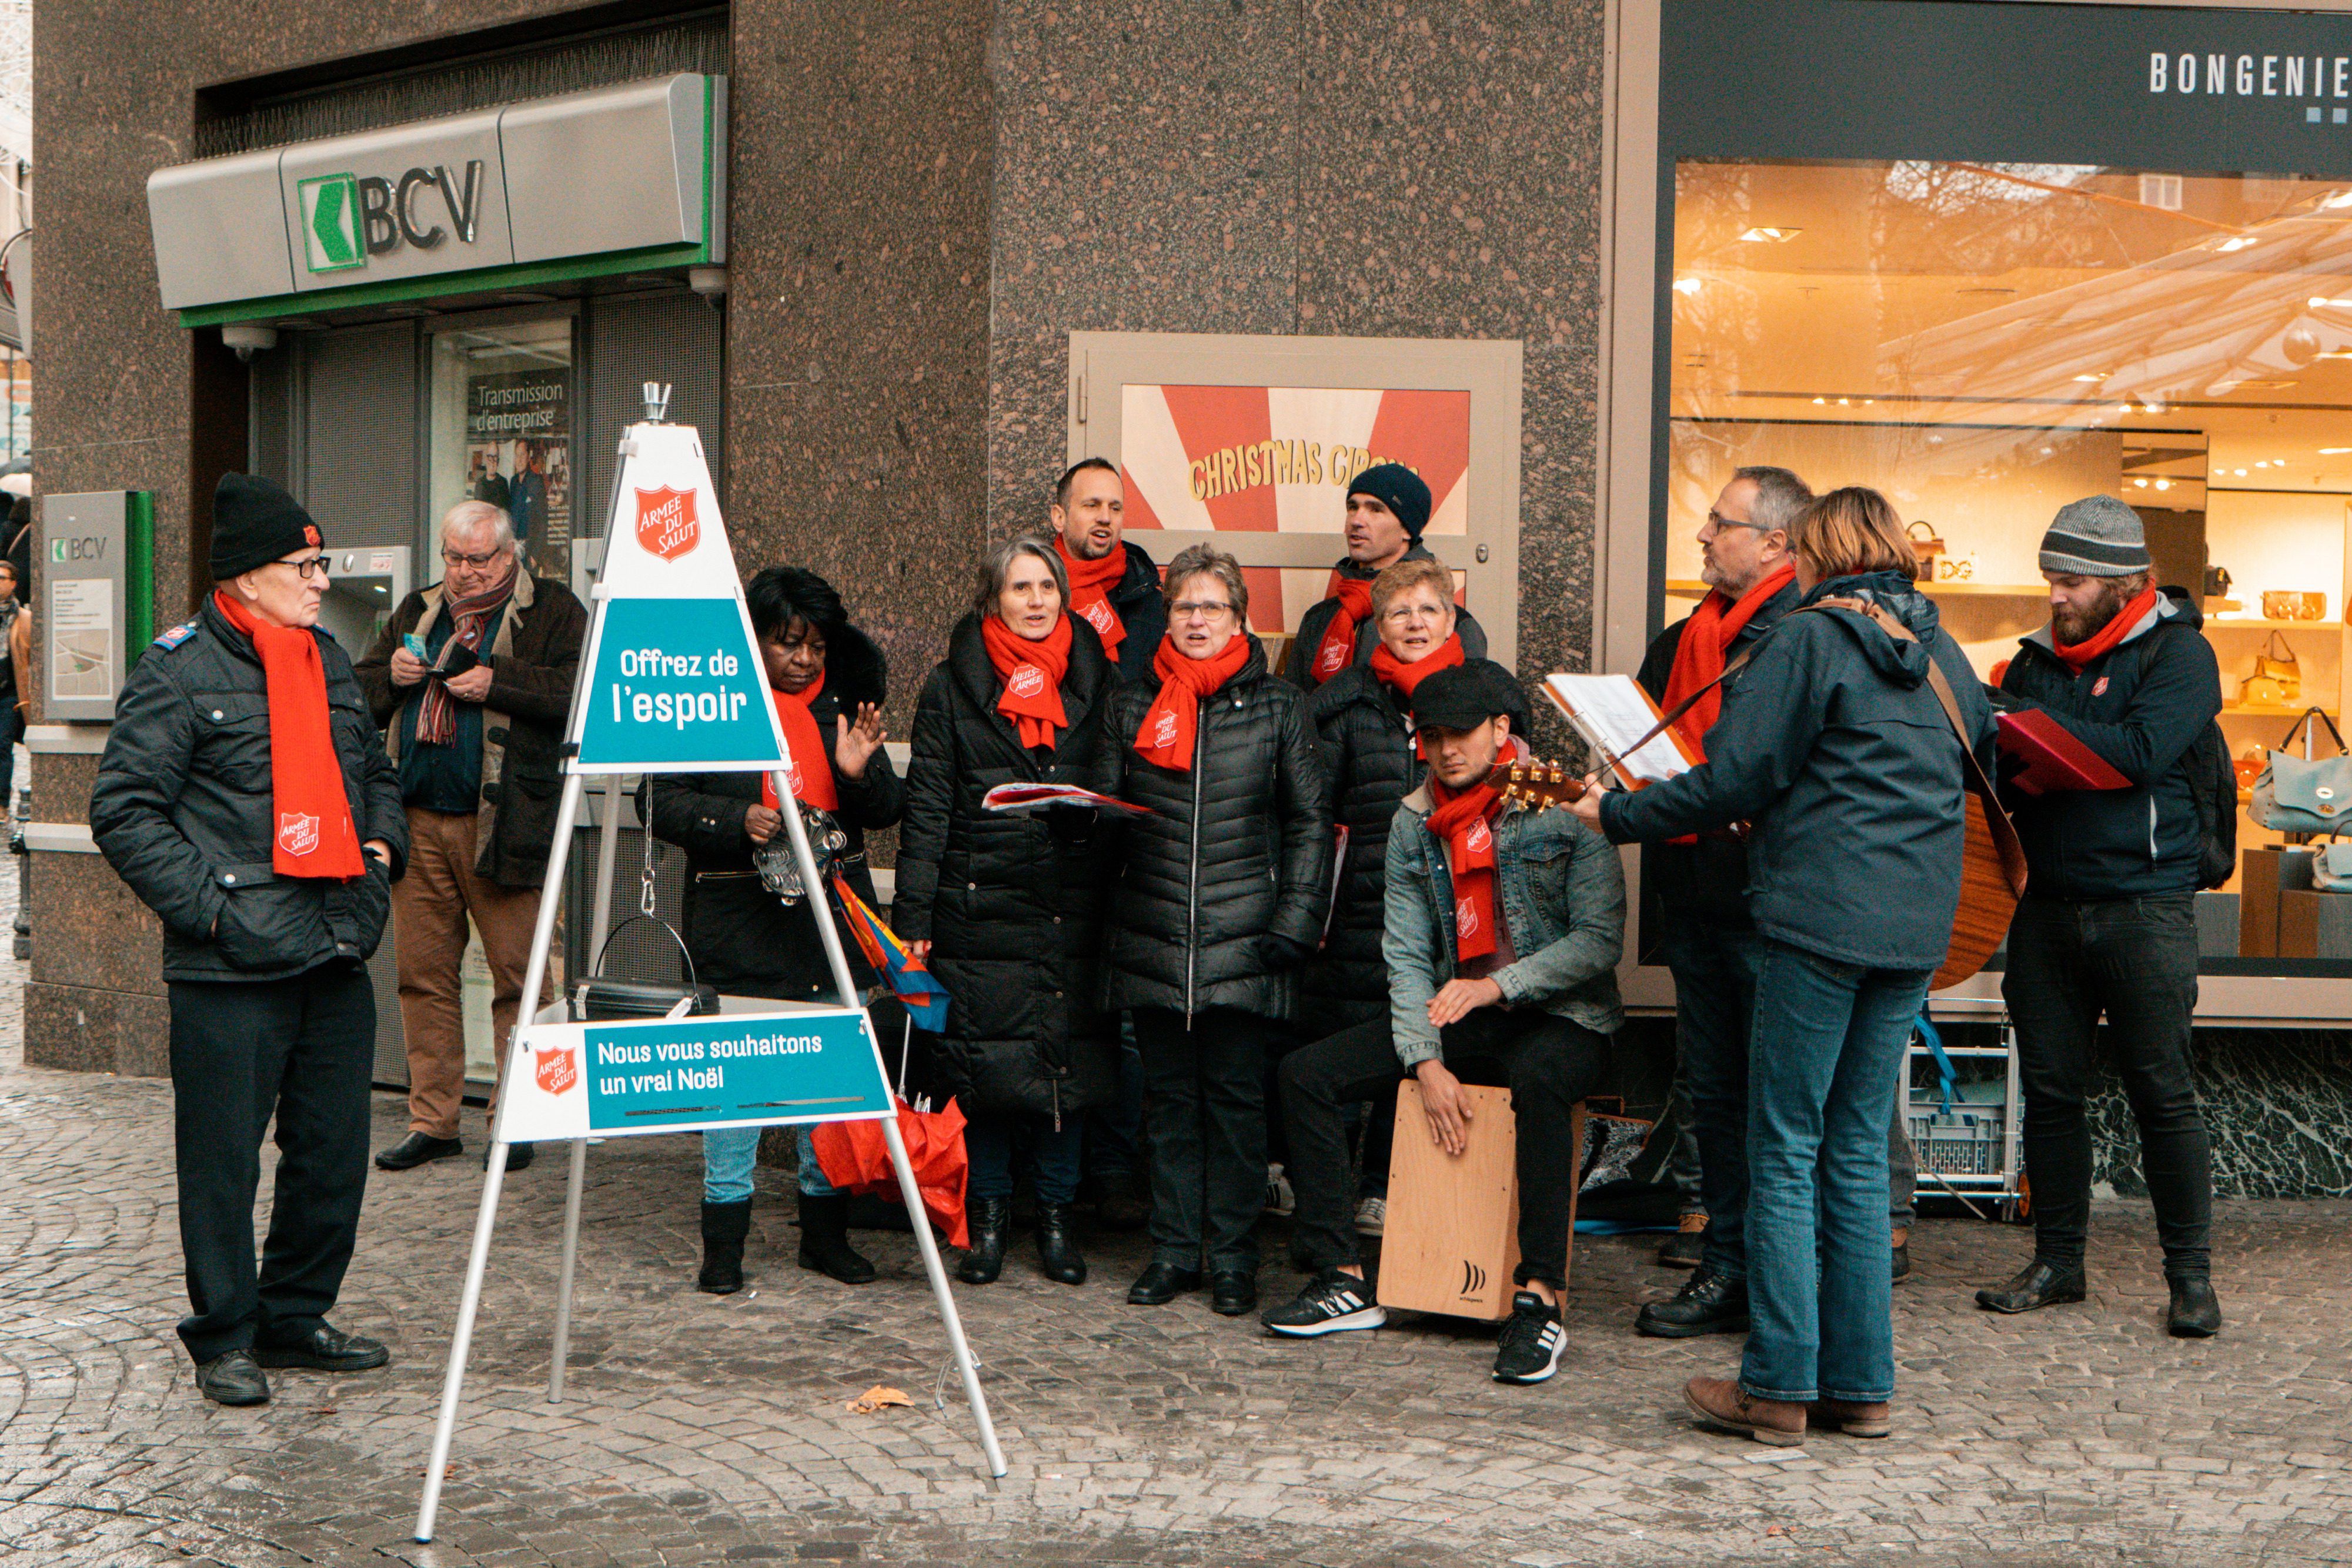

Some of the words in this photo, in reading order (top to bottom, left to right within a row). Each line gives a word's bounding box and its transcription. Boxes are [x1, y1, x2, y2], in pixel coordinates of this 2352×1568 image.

[2150, 52, 2350, 98] BONGENIE
[359, 159, 482, 255] BCV
[477, 380, 563, 406] Transmission
[477, 404, 554, 434] d'entreprise
[1188, 439, 1323, 502] CHRISTMAS
[1328, 444, 1419, 490] CIR
[639, 495, 681, 533] ARMEE
[665, 511, 683, 534] DU
[71, 537, 107, 560] BCV
[659, 520, 696, 554] SALUT
[1087, 605, 1099, 623] RMEE
[620, 648, 702, 677] Offrez
[709, 648, 738, 676] de
[1015, 675, 1041, 692] ARMEE
[1156, 730, 1177, 743] SALUT
[1161, 724, 1172, 734] DU
[281, 818, 310, 838] ARMEE
[296, 827, 309, 840] DU
[1467, 824, 1487, 849] ARMEE
[291, 833, 316, 851] SALUT
[598, 1042, 652, 1065] Nous
[656, 1042, 704, 1061] vous
[710, 1034, 823, 1059] souhaitons
[538, 1052, 566, 1079] ARMEE
[554, 1062, 567, 1079] DU
[550, 1068, 574, 1092] SALUT
[600, 1076, 626, 1095] un
[631, 1069, 672, 1094] vrai
[677, 1065, 724, 1091] Noël
